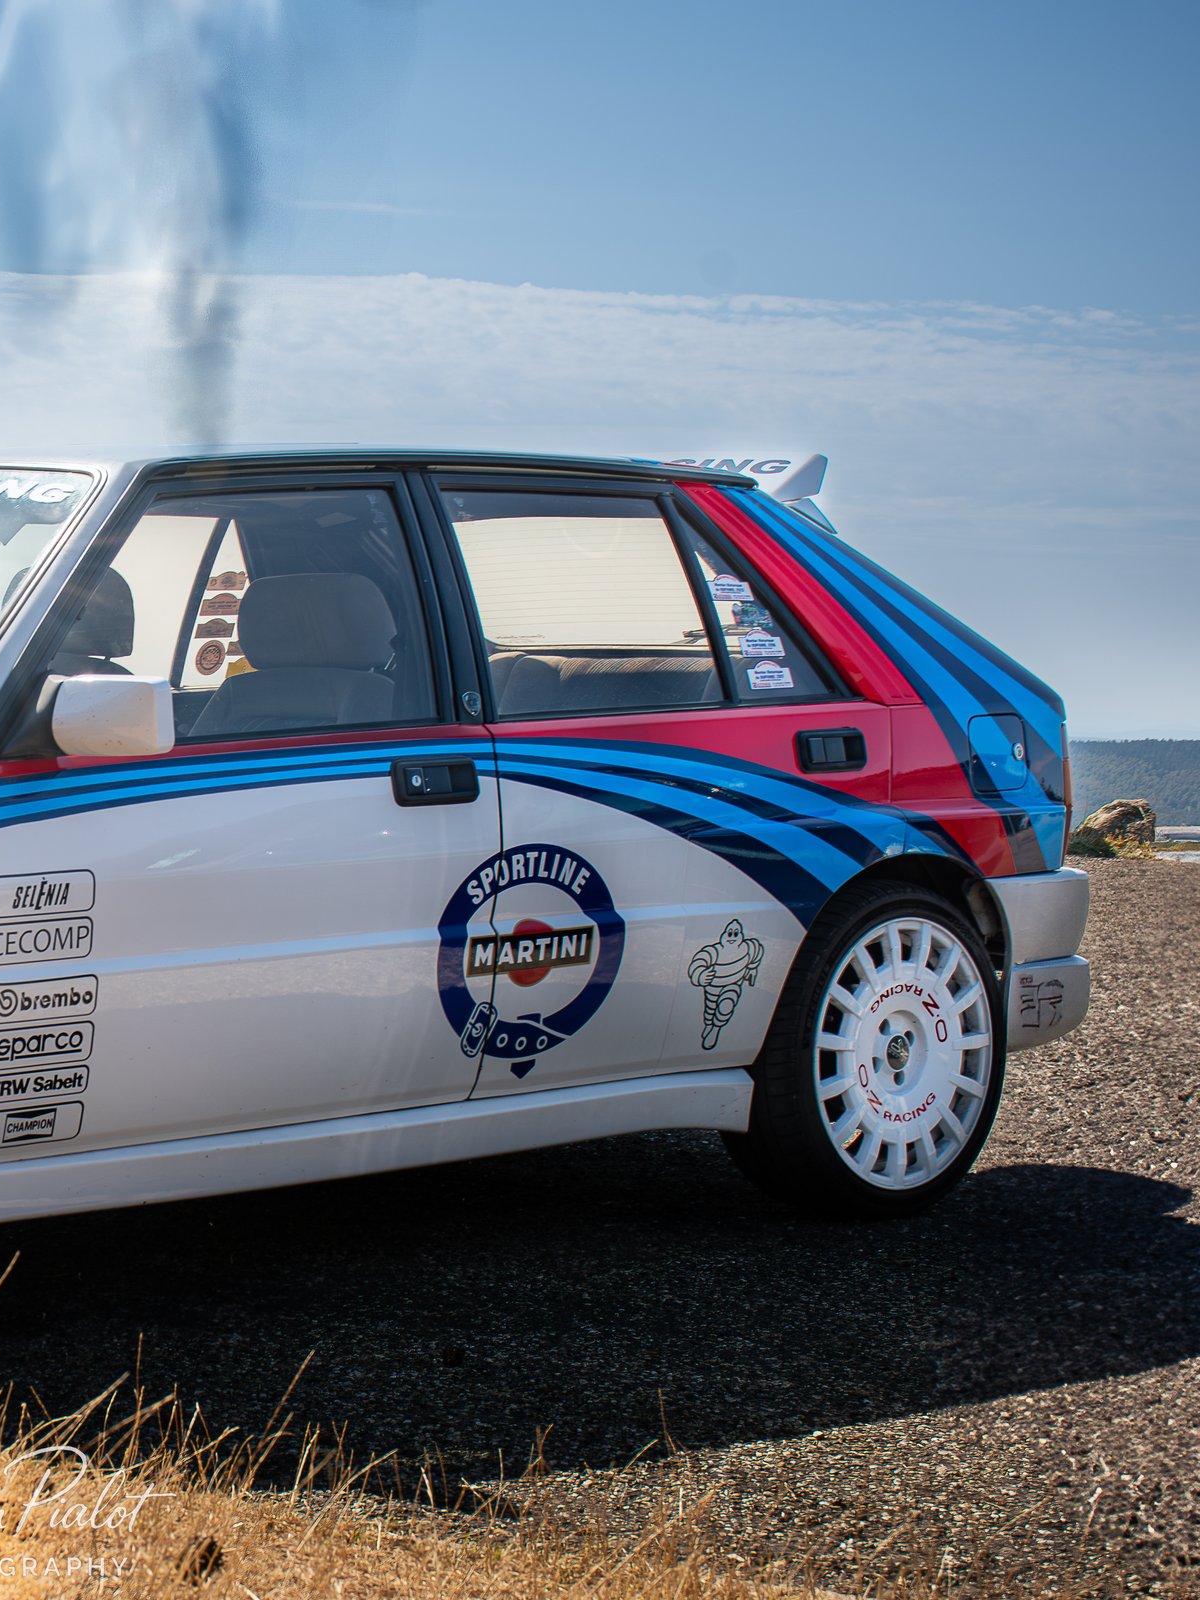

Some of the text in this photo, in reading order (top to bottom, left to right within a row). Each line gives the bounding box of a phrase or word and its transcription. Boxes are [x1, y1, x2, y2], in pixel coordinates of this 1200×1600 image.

[466, 851, 591, 905] SPORTLINE
[474, 934, 588, 968] MARTINI
[21, 988, 93, 1011] brembo
[871, 984, 924, 1013] RACING
[33, 1071, 84, 1093] Sabelt
[883, 1092, 936, 1123] RACING
[6, 1118, 54, 1134] CHAMPION
